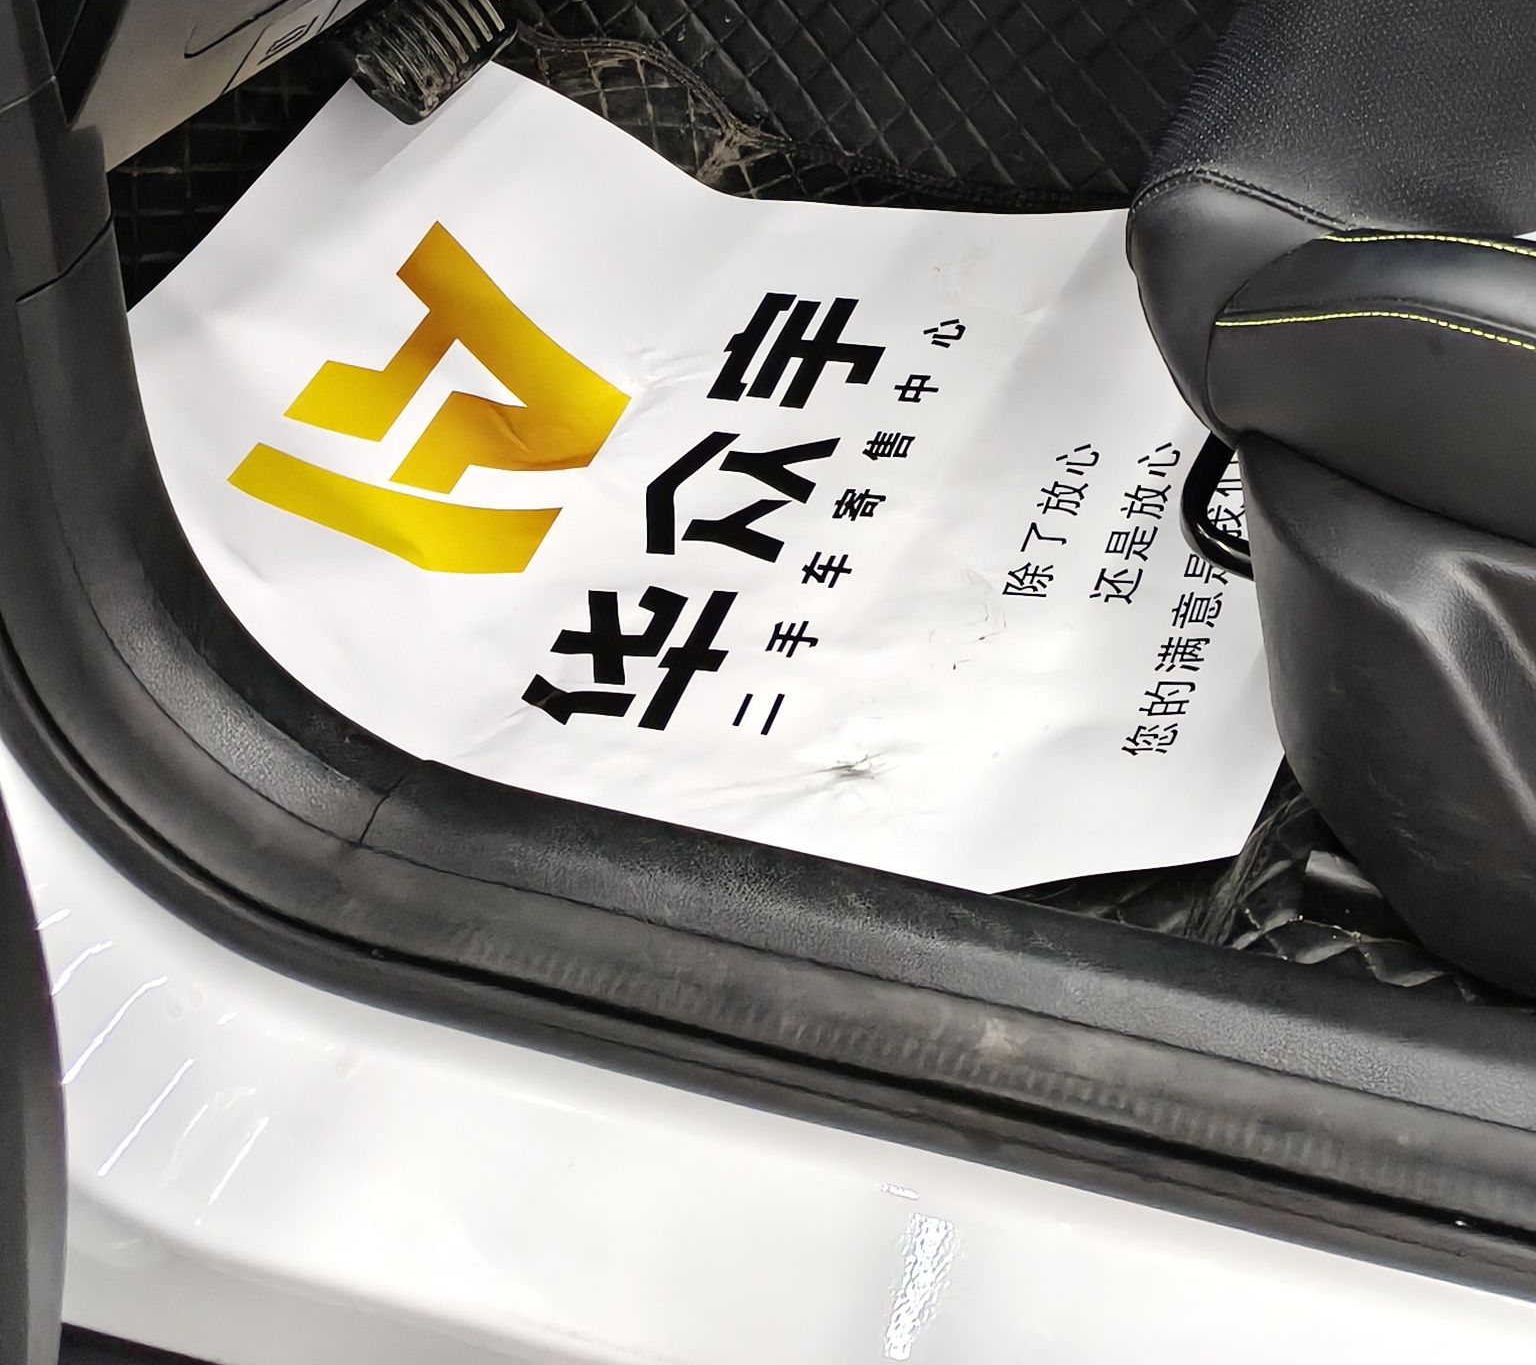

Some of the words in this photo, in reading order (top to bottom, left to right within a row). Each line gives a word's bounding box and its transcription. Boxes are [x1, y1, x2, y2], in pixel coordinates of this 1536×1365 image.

[521, 292, 886, 731] 华众宇
[732, 319, 966, 736] 二手车寄售中心
[1002, 443, 1100, 598] 除了放心
[1089, 442, 1182, 605] 还是放心
